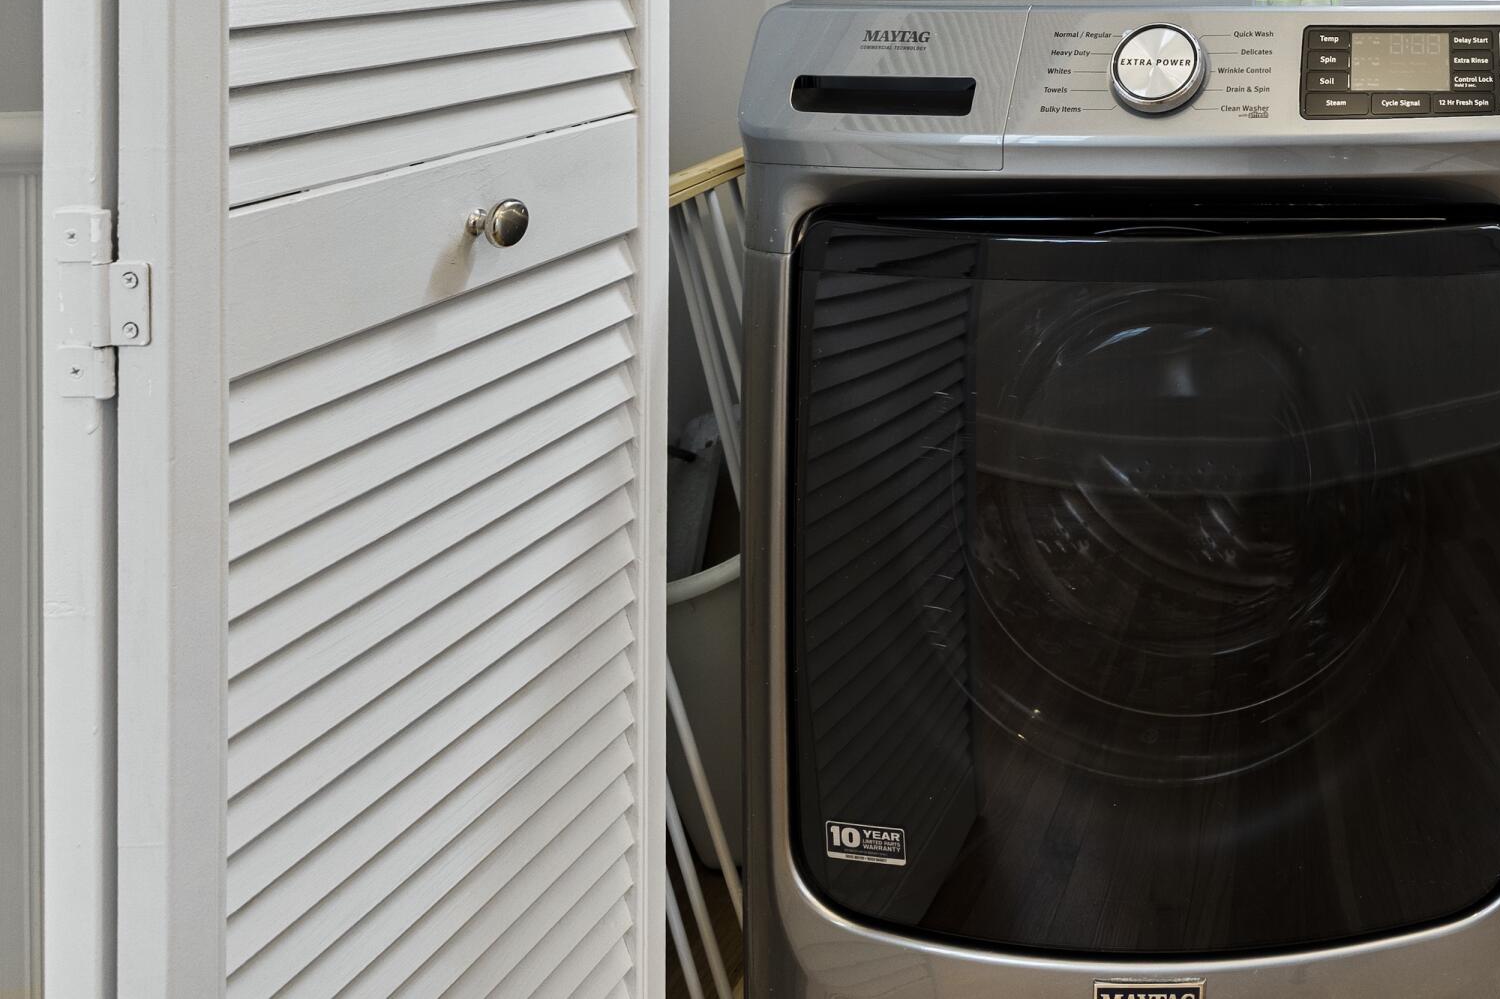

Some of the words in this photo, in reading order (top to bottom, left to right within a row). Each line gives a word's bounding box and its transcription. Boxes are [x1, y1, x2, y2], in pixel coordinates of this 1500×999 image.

[863, 30, 931, 43] MAYTAG
[1085, 31, 1112, 39] Regular
[1233, 30, 1253, 38] Quick
[1319, 35, 1339, 43] Temp
[1453, 36, 1472, 44] Delay
[1051, 49, 1072, 57] Heavy
[1074, 49, 1091, 57] Duty
[1240, 48, 1273, 56] Delicates
[1120, 58, 1152, 66] EXTRA
[1320, 56, 1337, 64] Spin
[1319, 77, 1335, 85] Soil
[1254, 86, 1270, 94] Spin
[1381, 99, 1399, 107] Cycle
[1400, 99, 1421, 107] Signal
[1474, 99, 1489, 107] Spin
[1040, 105, 1060, 114] Bulky
[1061, 105, 1081, 113] Items
[830, 825, 861, 848] 10
[862, 829, 900, 842] YEAR
[863, 844, 901, 853] WARRANTY
